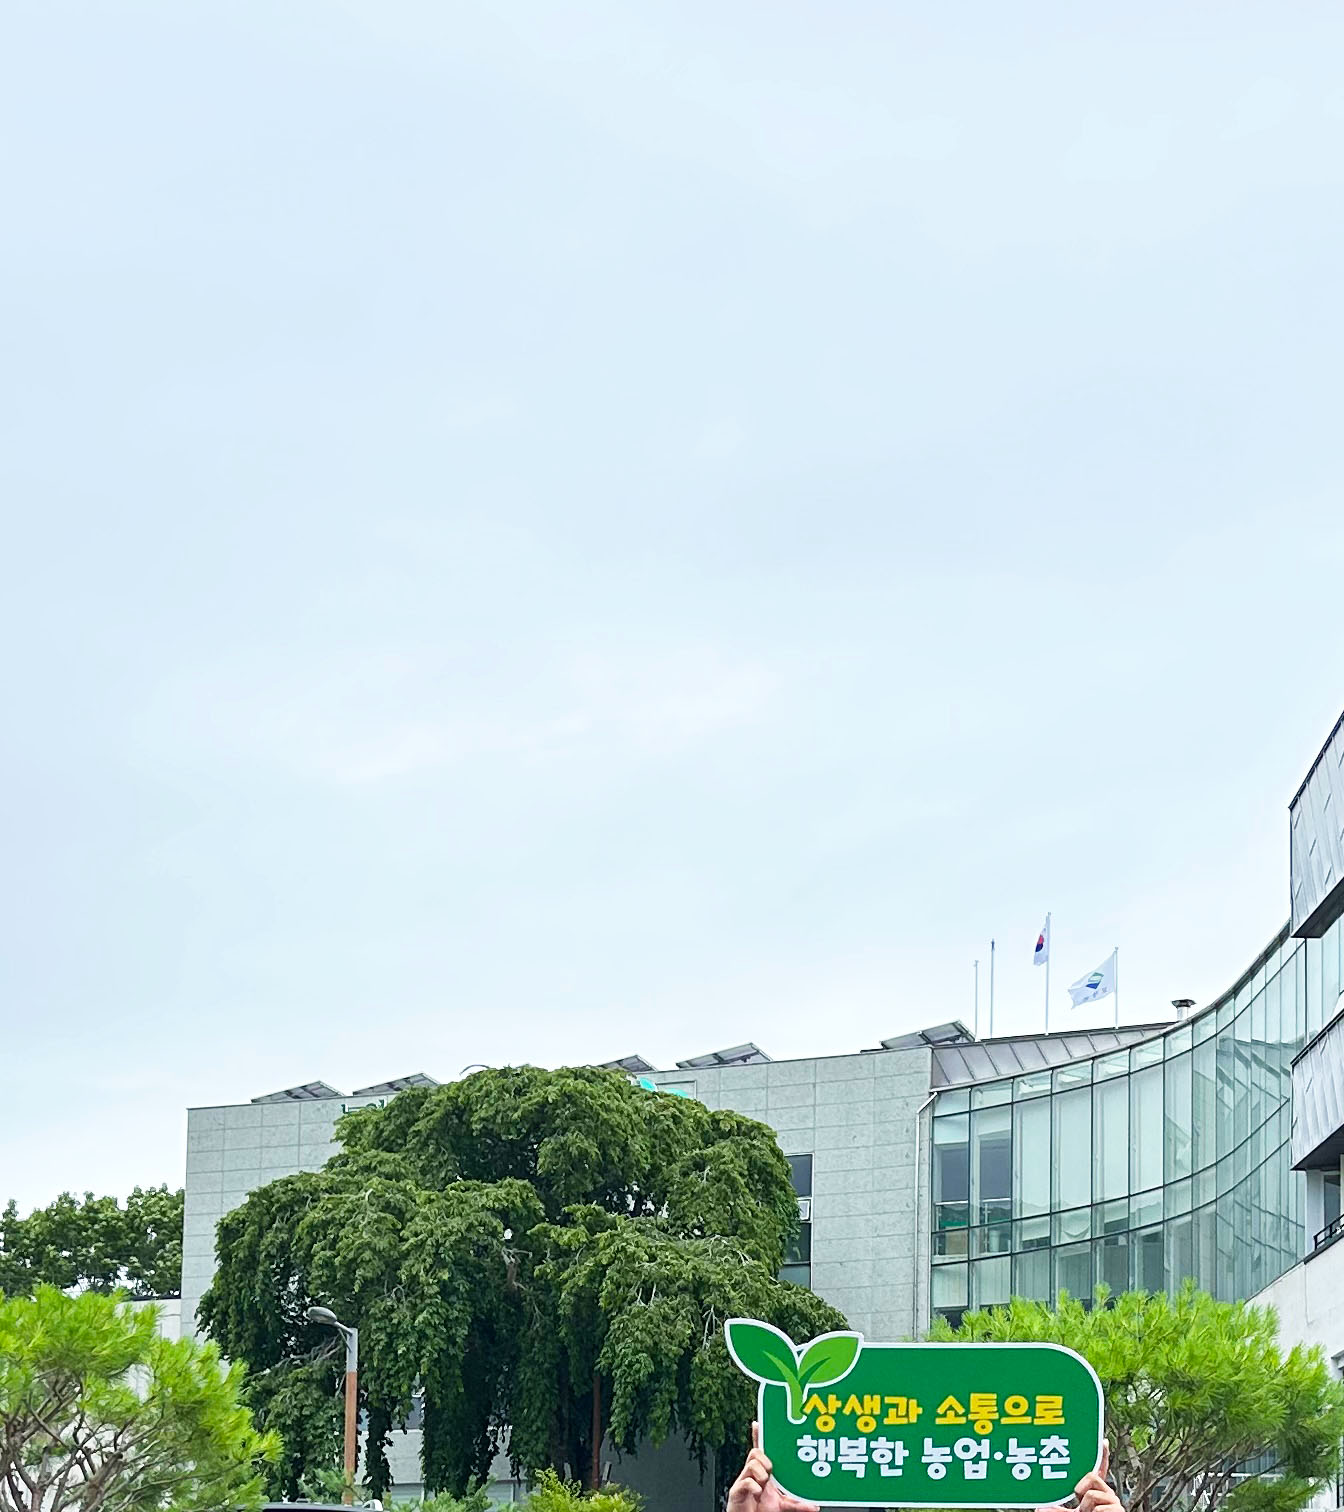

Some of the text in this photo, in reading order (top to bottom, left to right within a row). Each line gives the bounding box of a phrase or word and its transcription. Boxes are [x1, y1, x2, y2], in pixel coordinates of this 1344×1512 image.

[803, 1393, 1066, 1435] 상생과 소통으로
[796, 1434, 1071, 1481] 행복한 농업·농촌
